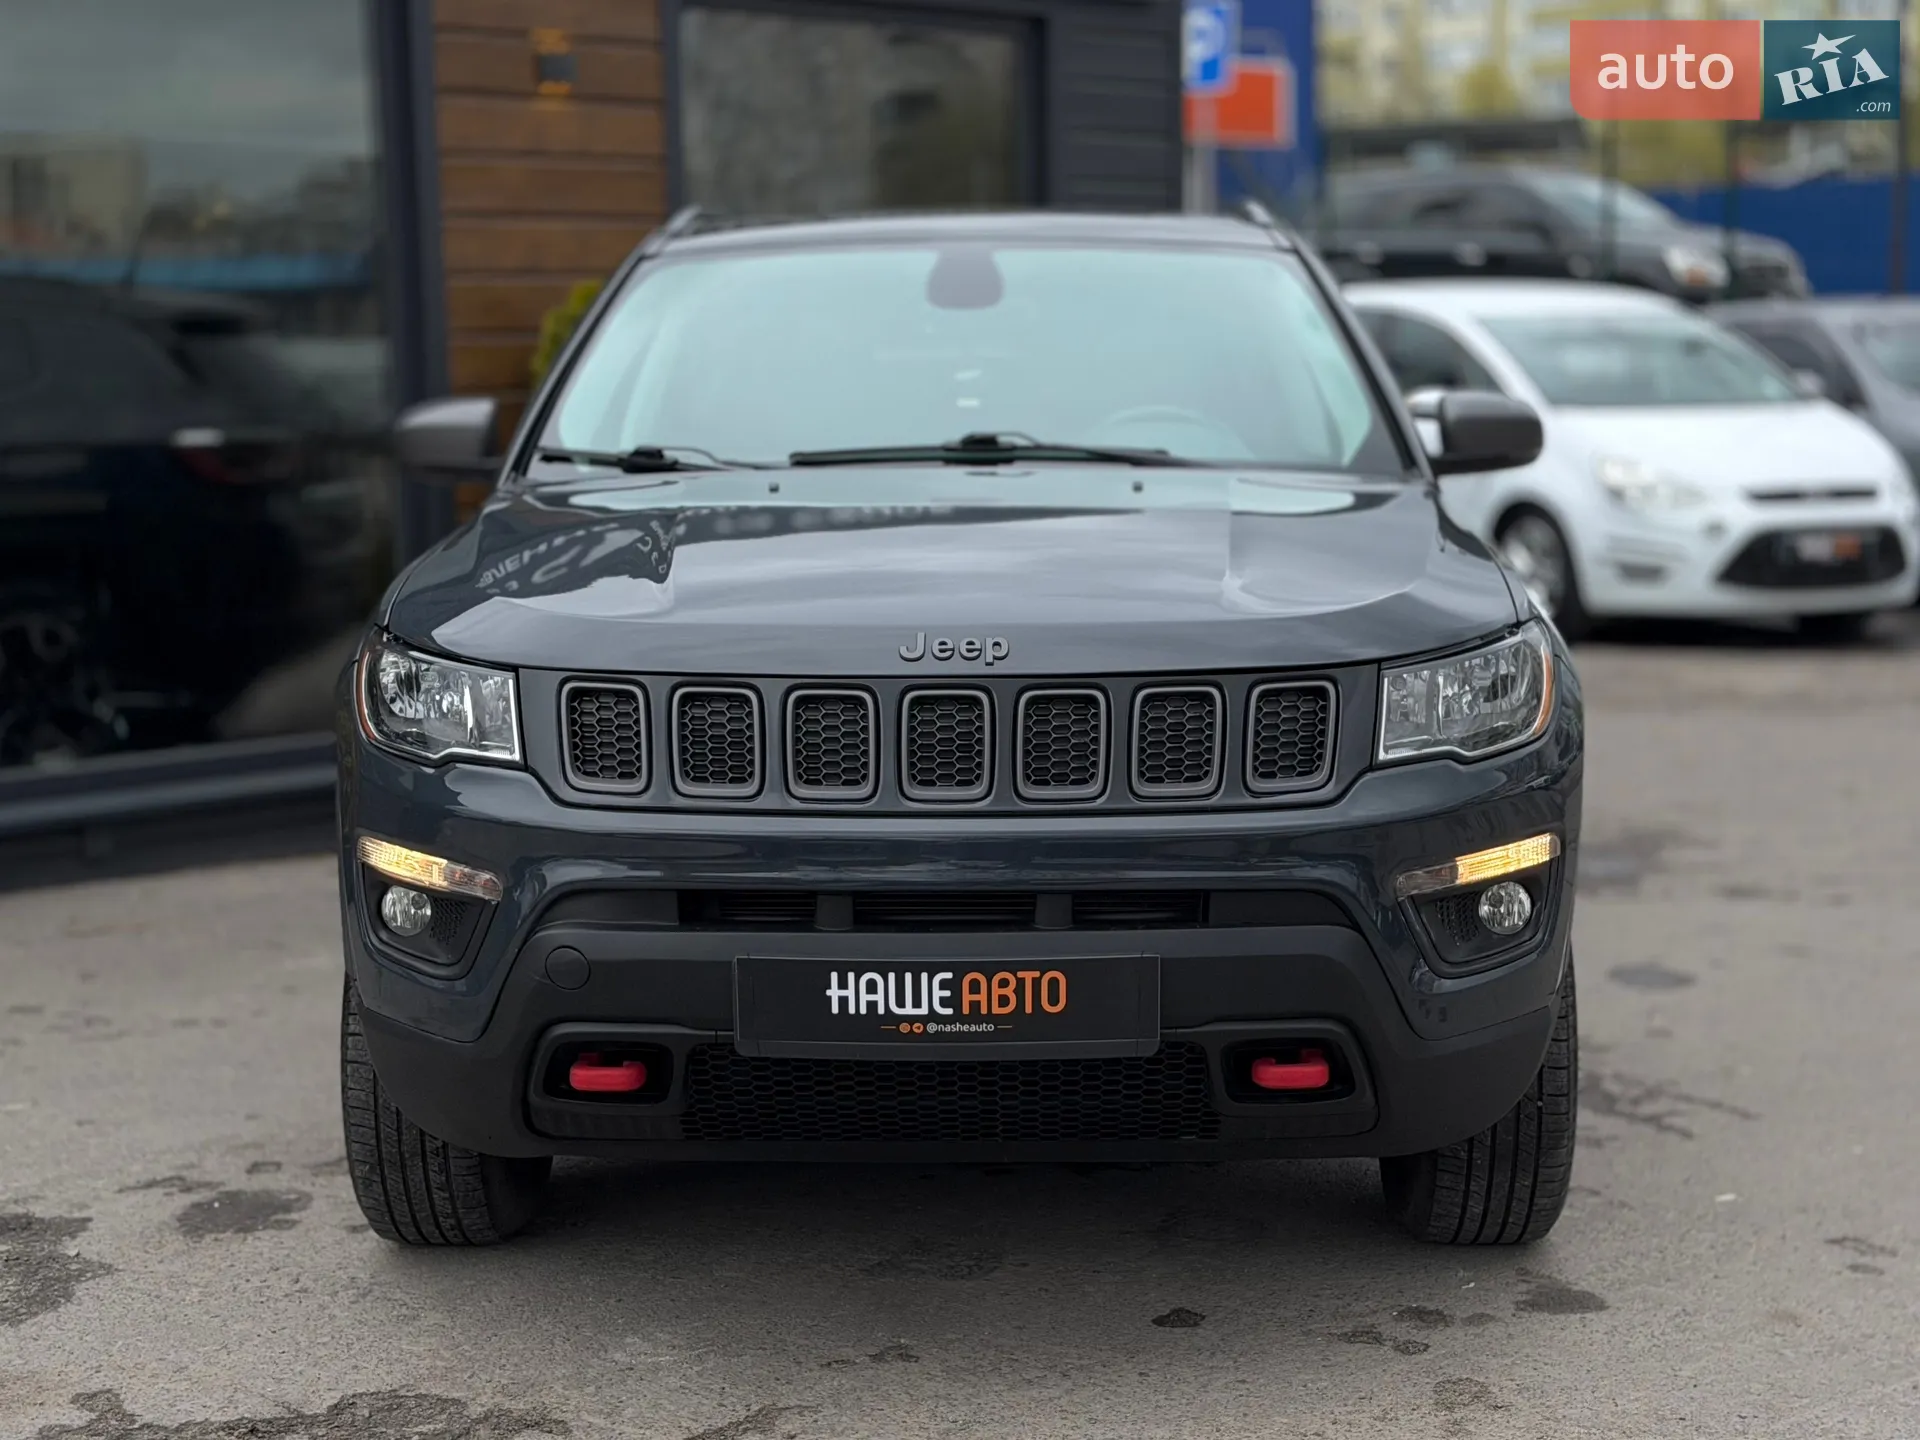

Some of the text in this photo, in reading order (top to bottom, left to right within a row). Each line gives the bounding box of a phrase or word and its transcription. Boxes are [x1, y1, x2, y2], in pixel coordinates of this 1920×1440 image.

[898, 632, 1009, 666] Jeep
[826, 970, 1067, 1015] НАШЕ АВТО
[926, 1021, 995, 1034] @nasheauto
